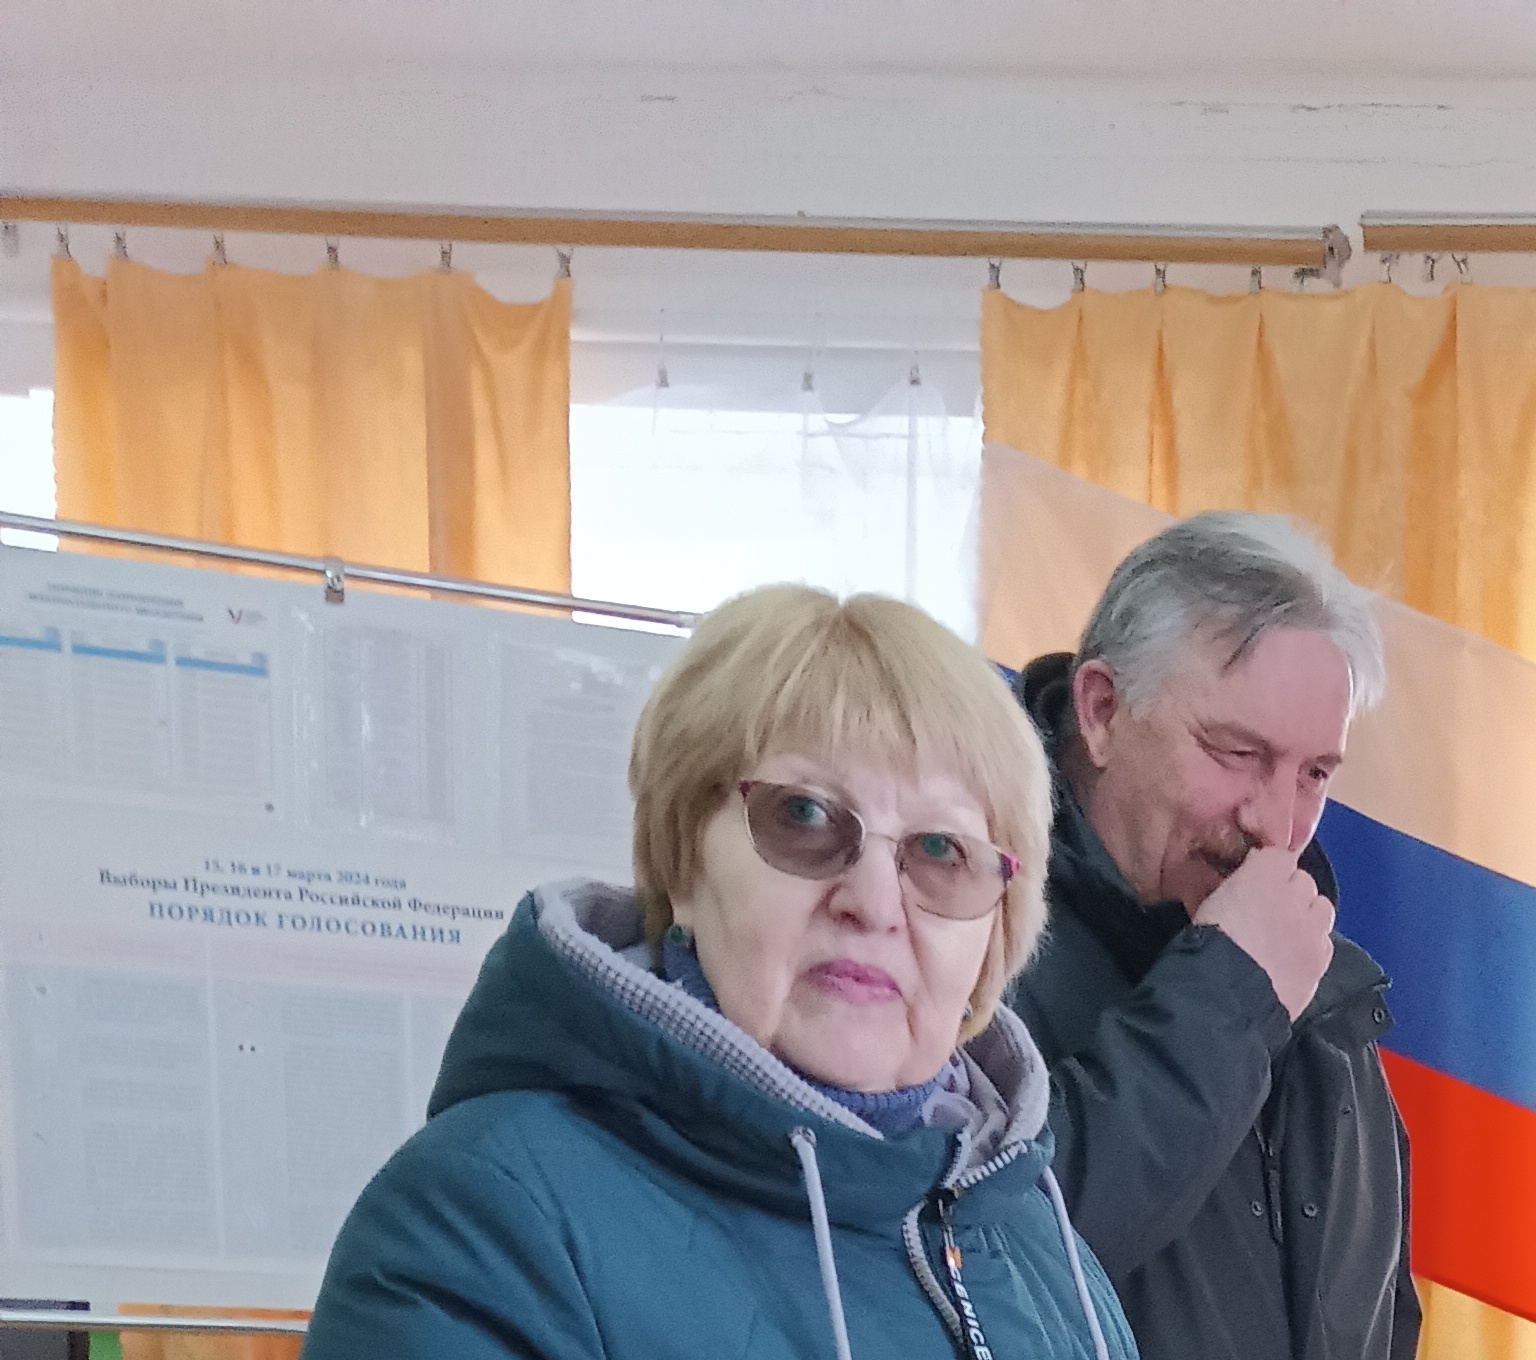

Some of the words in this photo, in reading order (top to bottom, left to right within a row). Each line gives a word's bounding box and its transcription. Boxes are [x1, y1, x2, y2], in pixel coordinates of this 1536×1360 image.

[99, 868, 178, 894] Выборы
[183, 876, 292, 901] Президента
[299, 888, 402, 912] Российской
[407, 898, 505, 921] Федерации
[230, 861, 248, 876] 16
[265, 863, 282, 877] 17
[286, 868, 332, 884] марта
[337, 869, 370, 886] 2024
[374, 874, 407, 890] года
[149, 901, 267, 928] ПОРЯДОК
[277, 914, 462, 944] ГОЛОСОВАНИЯ
